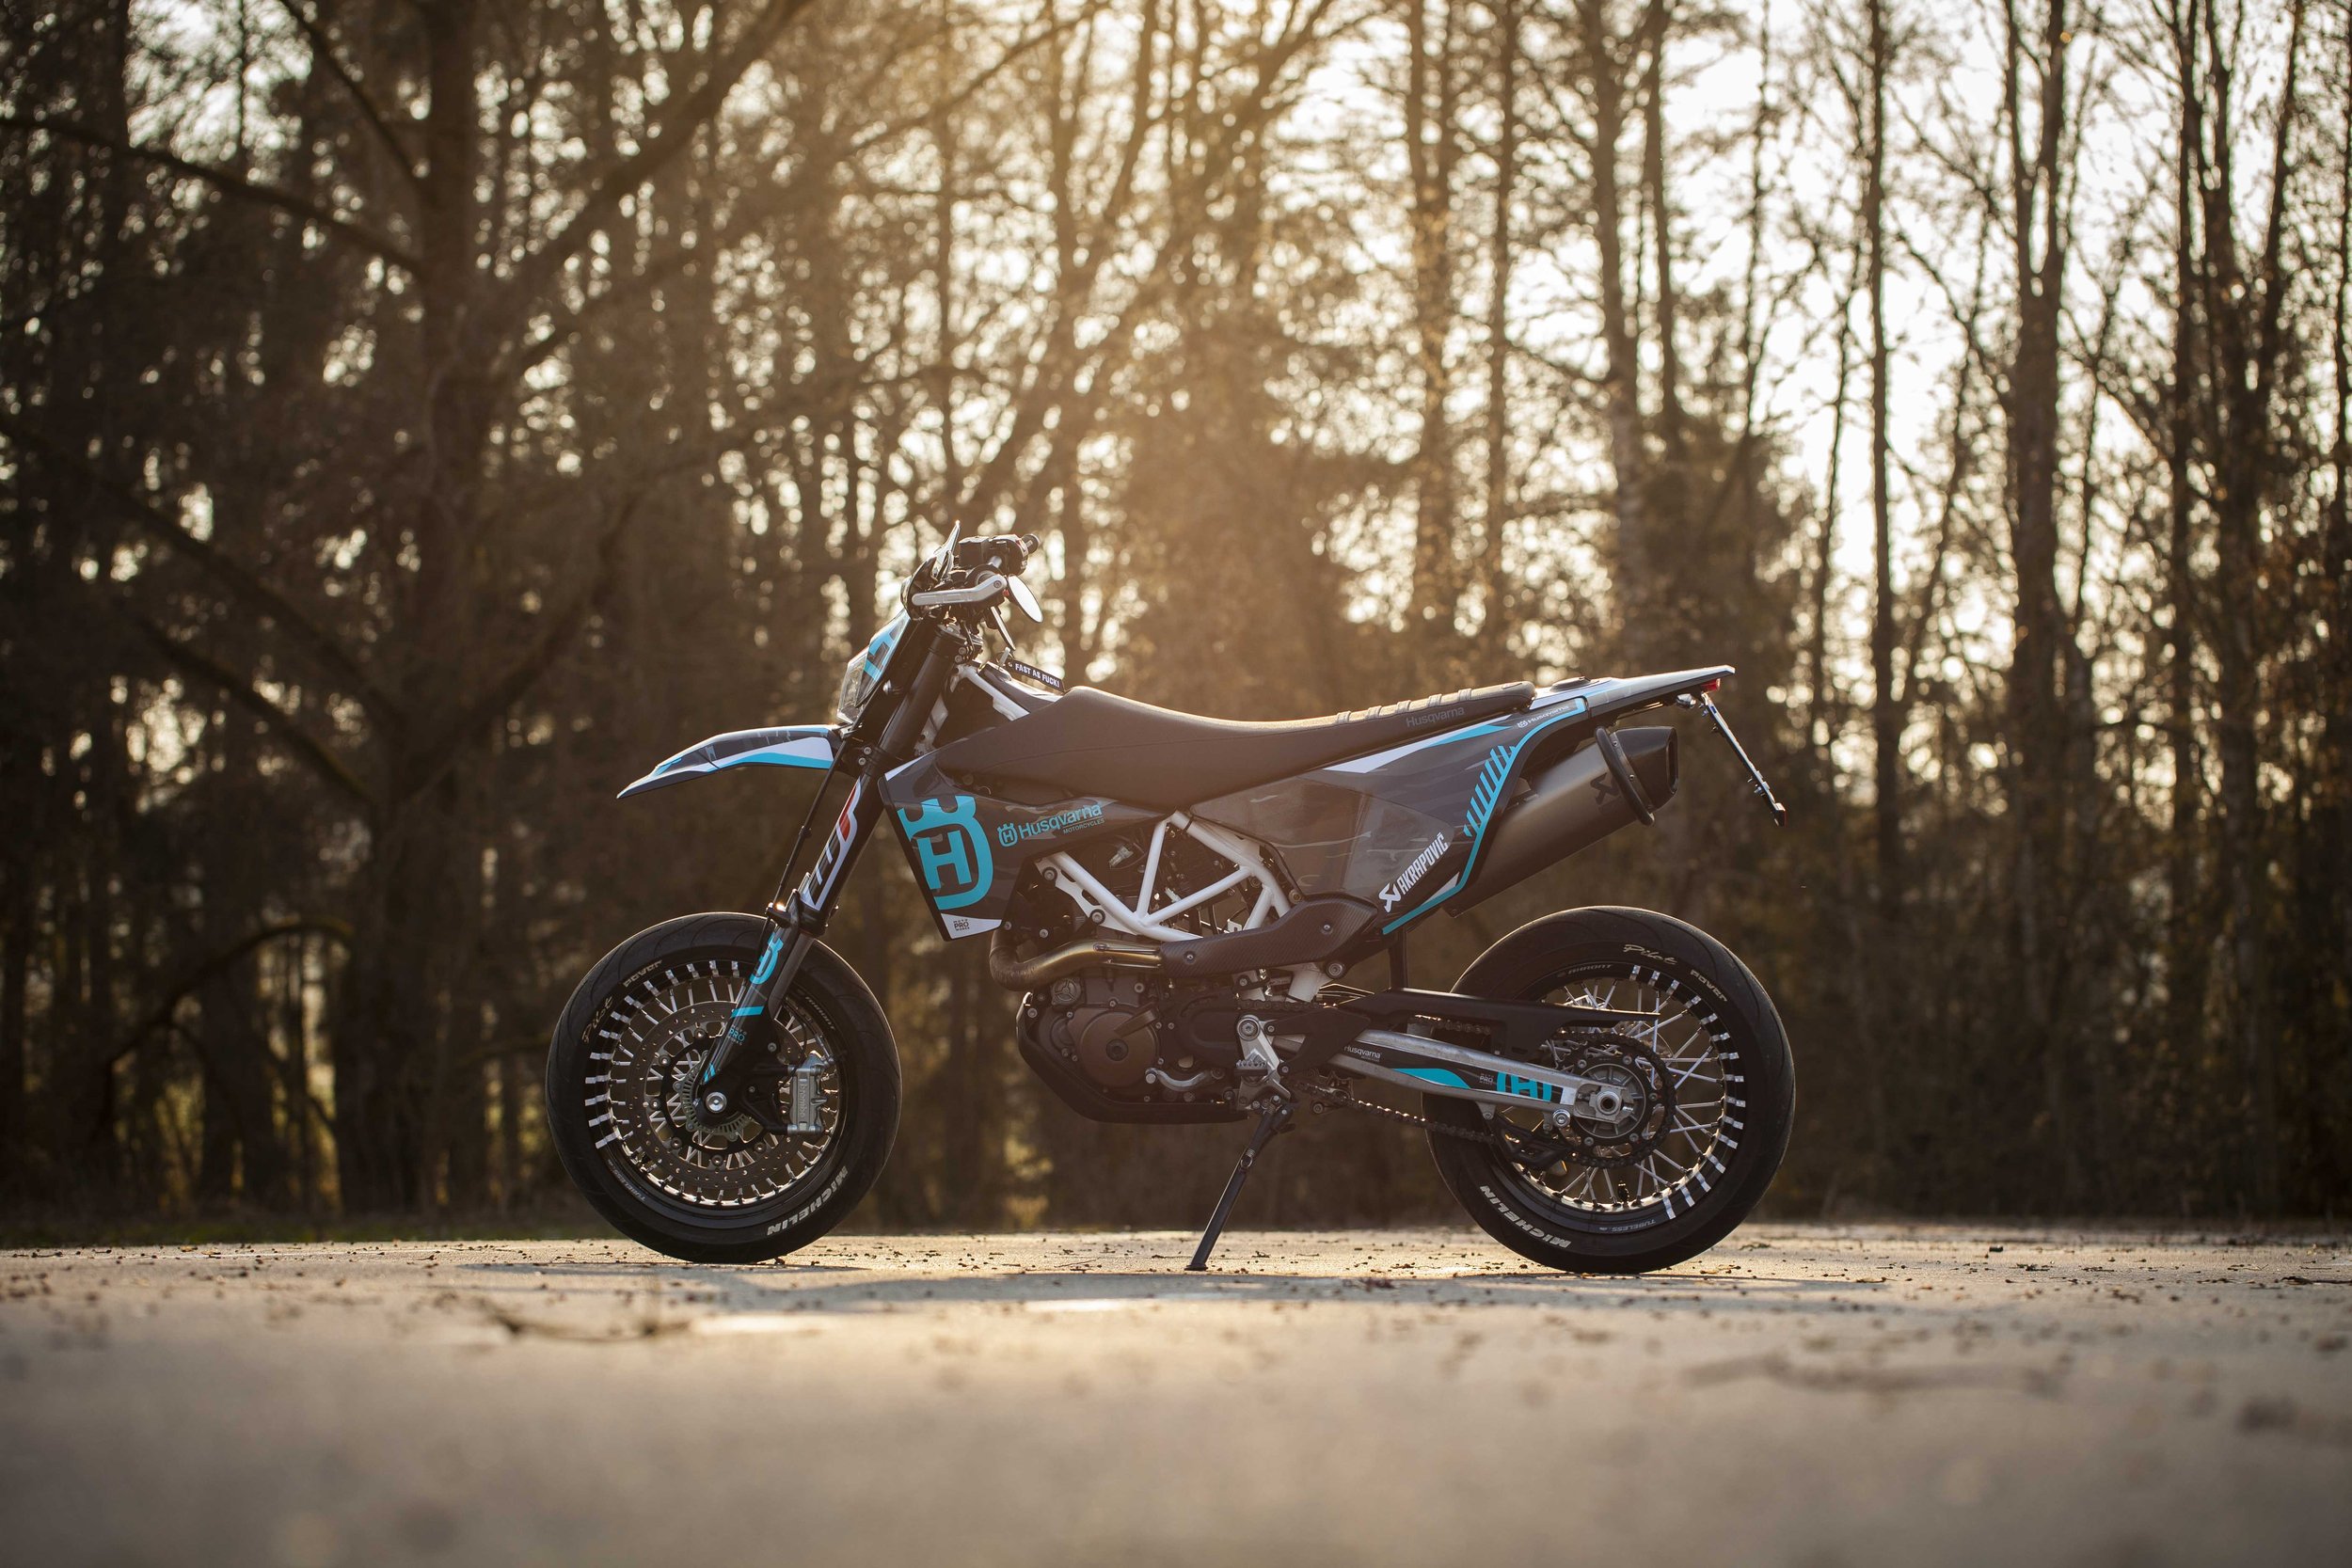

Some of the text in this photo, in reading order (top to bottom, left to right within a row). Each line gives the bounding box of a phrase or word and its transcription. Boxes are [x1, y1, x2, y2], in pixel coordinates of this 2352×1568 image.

[1015, 663, 1060, 688] FAST AS FUCK!
[1406, 706, 1465, 728] Husqvarna
[1018, 803, 1103, 839] Husqvarna
[1063, 818, 1104, 834] MOTORCYCLES
[1623, 943, 1677, 965] Pilot
[581, 996, 612, 1043] Pilot
[729, 1028, 745, 1042] PRO
[799, 1084, 808, 1119] brembo
[767, 1165, 848, 1236] MICHELIN
[1480, 1185, 1572, 1248] MICHELIN
[1612, 1219, 1656, 1232] TUBELESS
